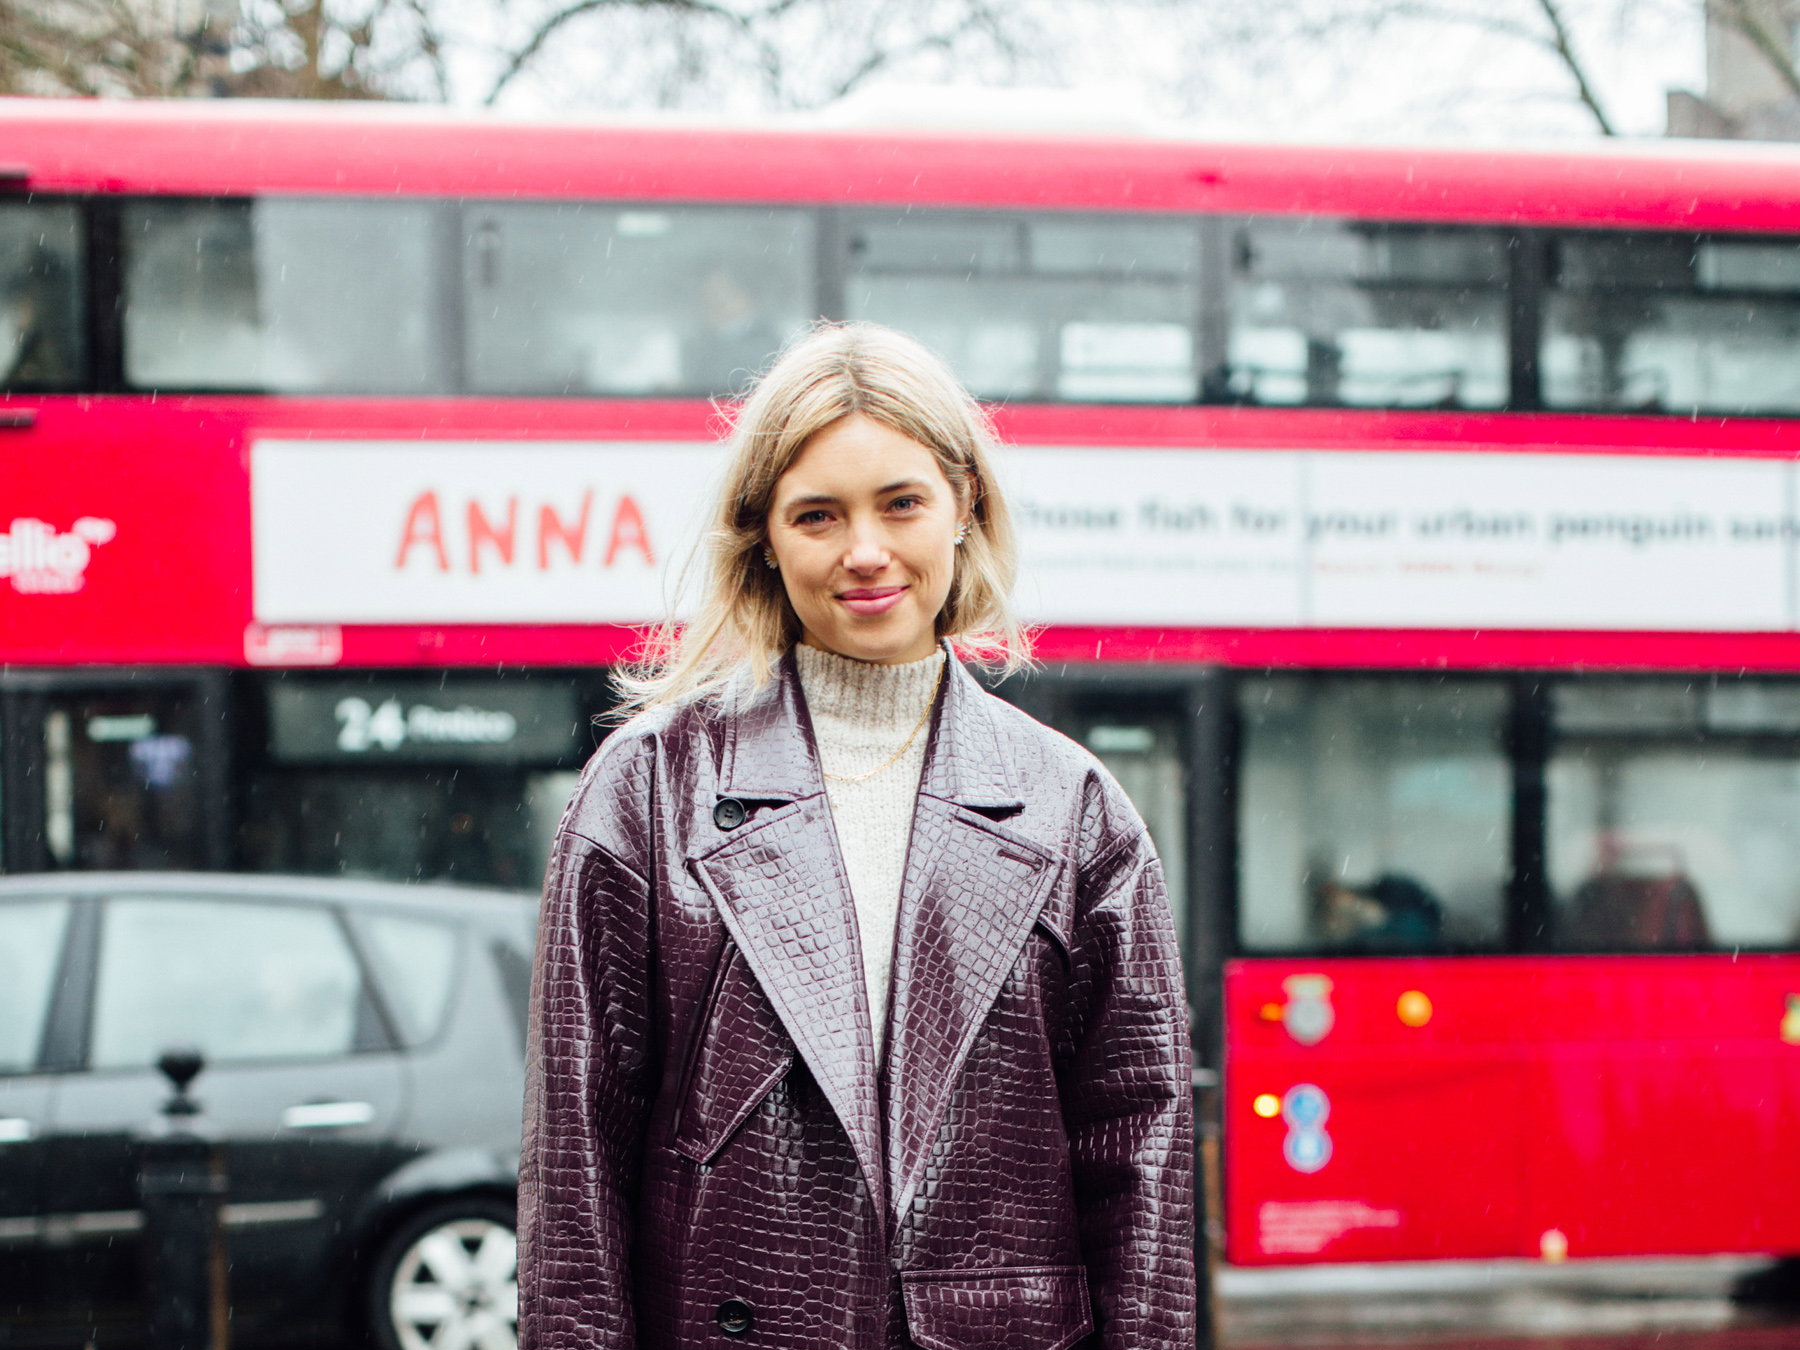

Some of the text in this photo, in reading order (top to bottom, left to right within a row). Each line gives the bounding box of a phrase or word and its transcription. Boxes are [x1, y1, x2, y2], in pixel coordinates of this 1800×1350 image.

[396, 488, 656, 573] ANNA
[1231, 496, 1285, 534] for
[1302, 507, 1396, 543] your
[1412, 501, 1533, 539] urban
[1547, 503, 1714, 553] penguin
[336, 698, 403, 752] 24
